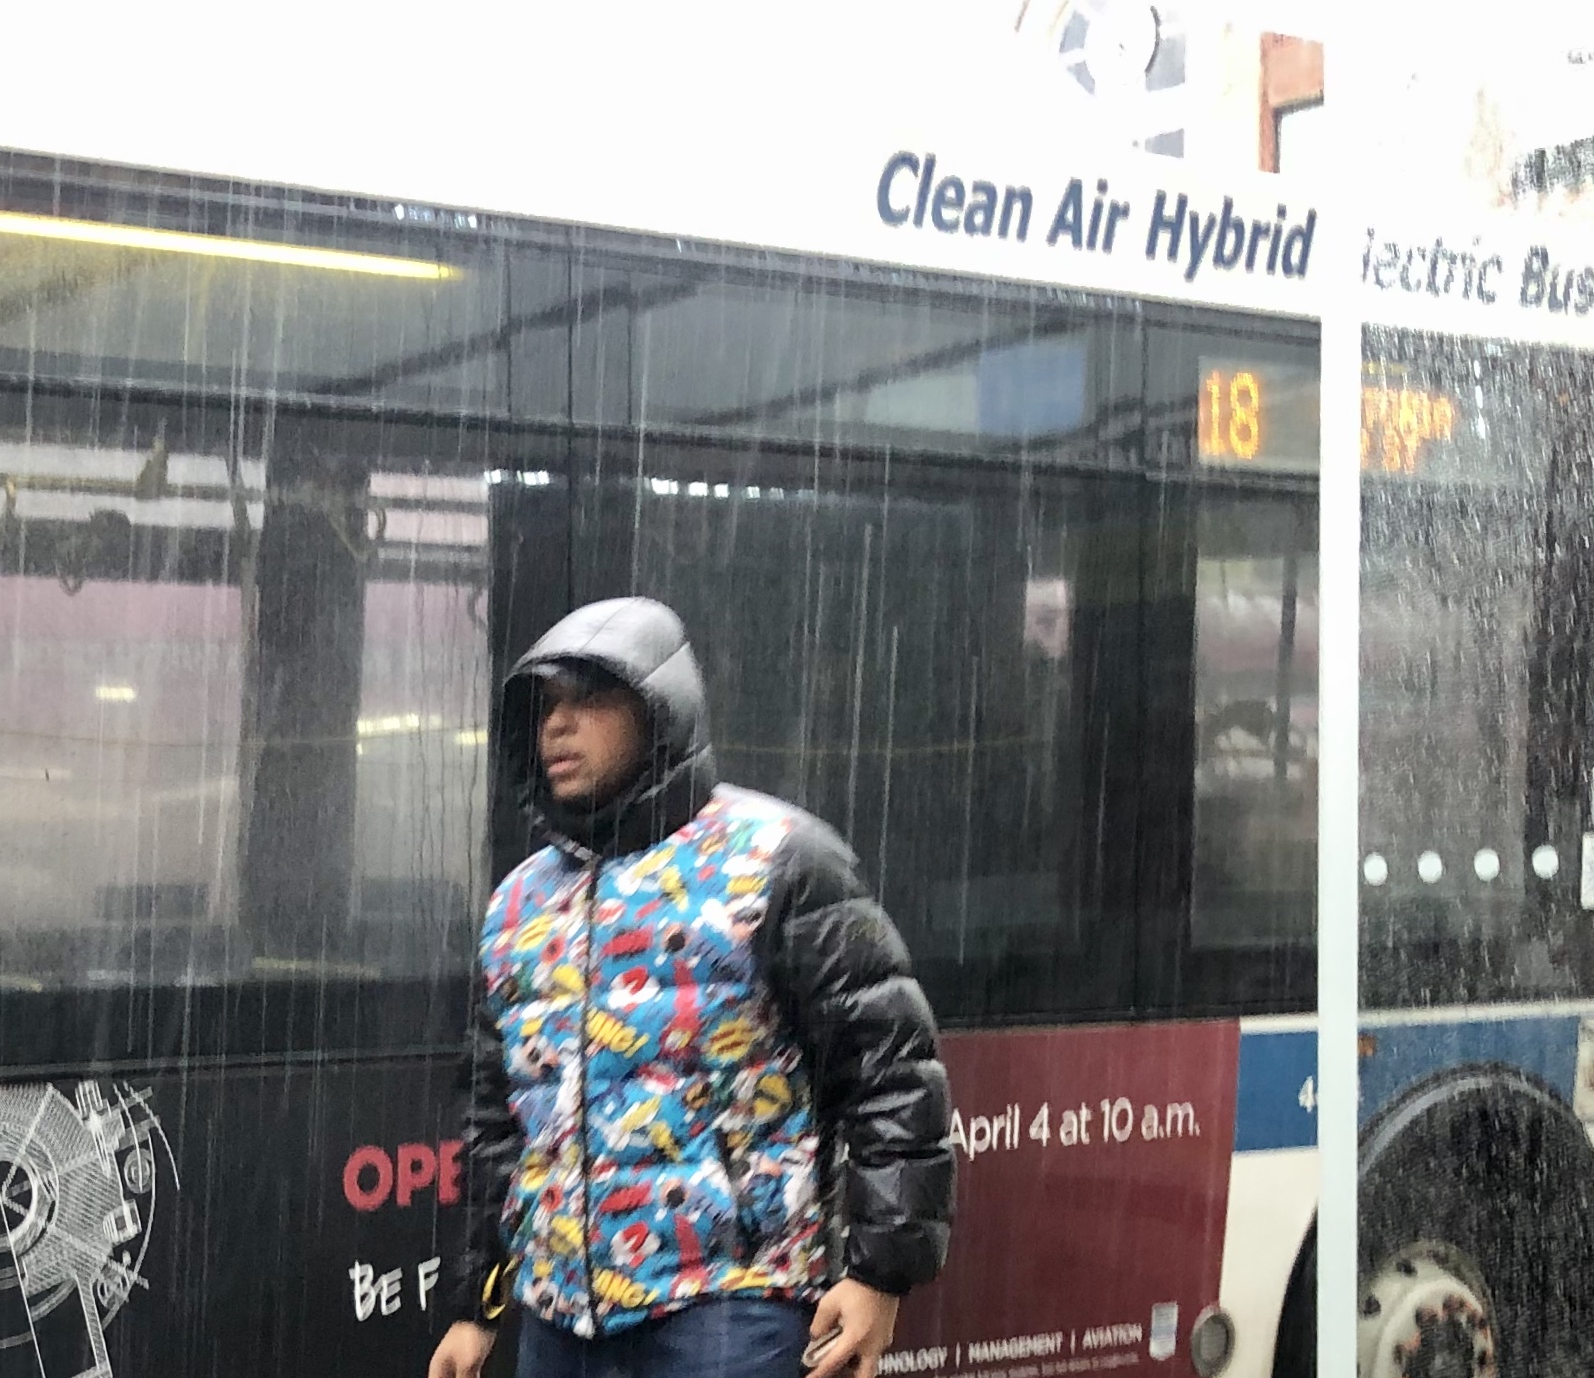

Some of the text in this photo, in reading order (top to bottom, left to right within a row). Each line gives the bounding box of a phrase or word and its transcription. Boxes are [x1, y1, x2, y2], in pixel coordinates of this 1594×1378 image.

[876, 149, 1034, 244] Clean
[1045, 176, 1130, 255] Air
[1144, 188, 1317, 284] Hybrid
[1204, 369, 1259, 460] 18
[948, 1096, 1201, 1161] April 4 at 10 a.m.
[349, 1259, 403, 1322] BE
[968, 1331, 1063, 1364] MANAGEMENT
[1082, 1322, 1143, 1351] AVIATION
